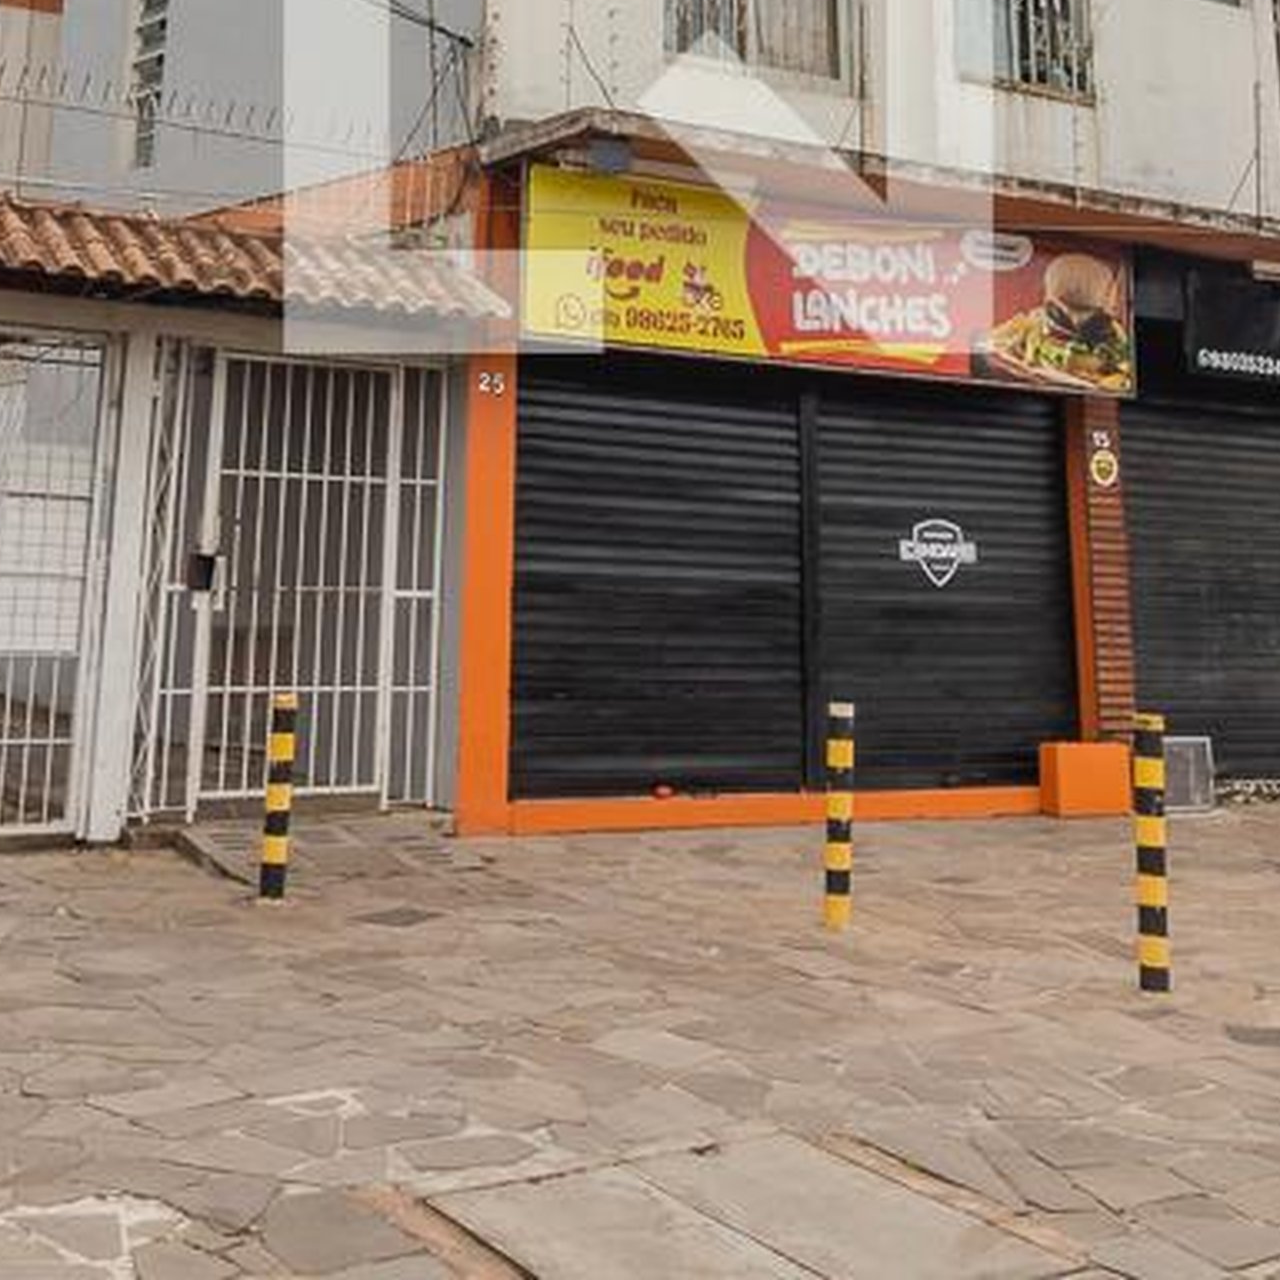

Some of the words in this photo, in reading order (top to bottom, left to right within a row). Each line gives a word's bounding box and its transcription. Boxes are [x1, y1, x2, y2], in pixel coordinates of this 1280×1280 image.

[792, 241, 936, 284] DEBONI
[791, 288, 952, 339] LANCHES
[479, 372, 505, 394] 25
